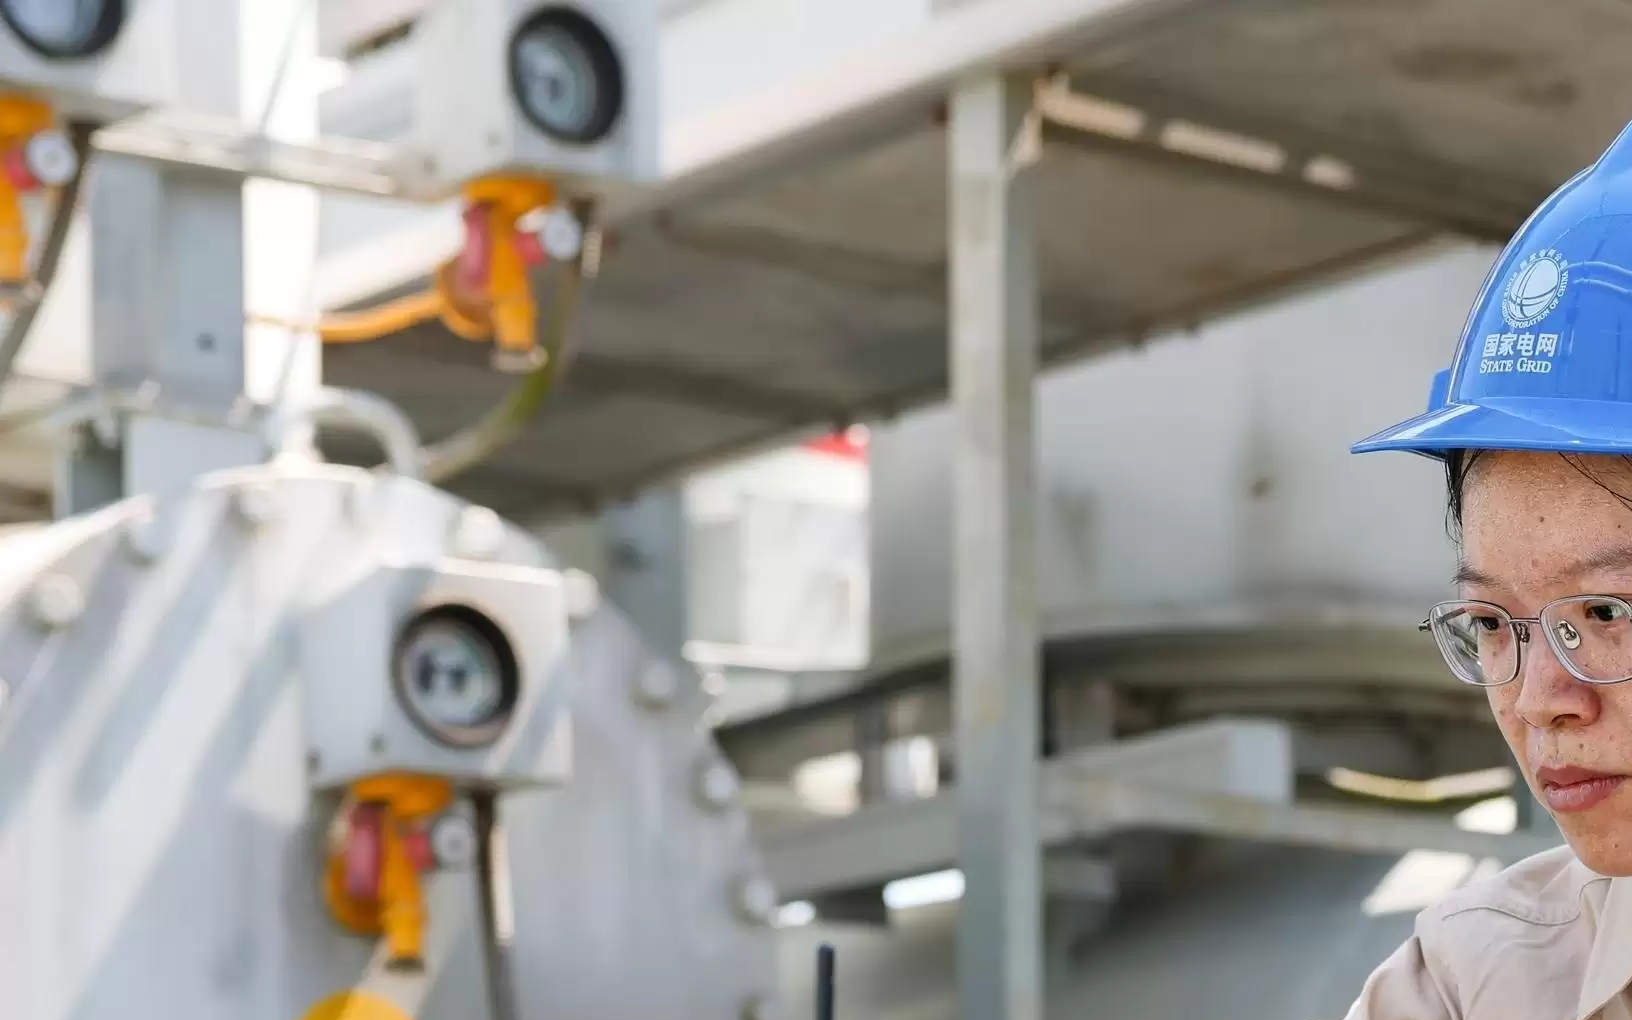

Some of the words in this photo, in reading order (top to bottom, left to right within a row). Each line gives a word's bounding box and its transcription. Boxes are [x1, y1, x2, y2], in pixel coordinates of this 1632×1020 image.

[1482, 332, 1558, 357] 国家电网
[1480, 359, 1513, 374] STATE
[1516, 357, 1552, 373] GRID
